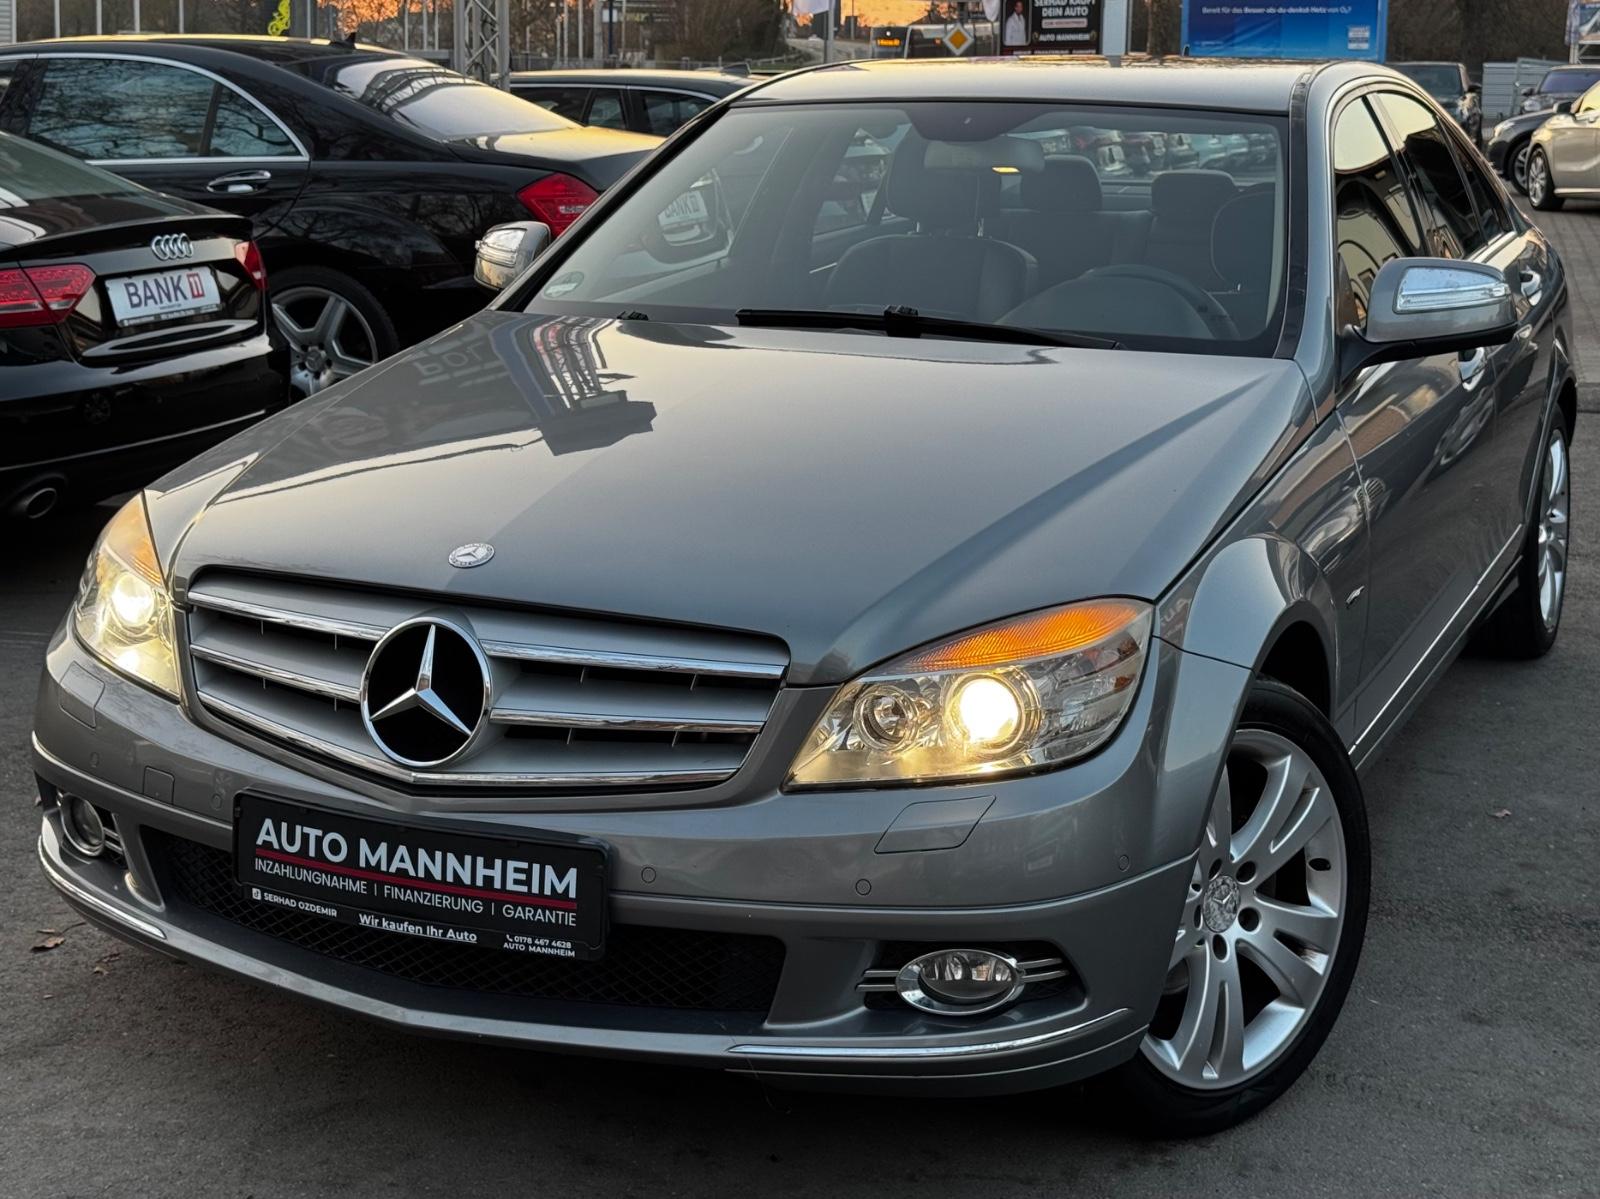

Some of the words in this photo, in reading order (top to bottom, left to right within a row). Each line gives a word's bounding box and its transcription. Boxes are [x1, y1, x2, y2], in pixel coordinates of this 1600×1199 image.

[1042, 7, 1063, 17] DEIN
[1064, 6, 1088, 16] AUTO
[1039, 33, 1055, 42] AUTO
[124, 275, 187, 308] BANK
[255, 817, 349, 864] AUTO
[359, 838, 578, 899] MANNHEIM
[255, 857, 367, 895] INZAHLUNGNAHME
[384, 884, 484, 914] FINANZIERUNG
[502, 904, 577, 927] GARANTIE
[263, 892, 297, 908] SERHAD
[298, 901, 338, 918] OZDEMIR
[359, 912, 380, 927] Wir
[382, 916, 423, 935] kaufen
[426, 924, 443, 939] Ihr
[446, 928, 478, 943] Auto
[503, 942, 526, 951] AUTO
[528, 945, 576, 958] MANNHEIM
[513, 935, 533, 944] 0178
[534, 938, 550, 946] 467
[551, 940, 572, 949] 4628
